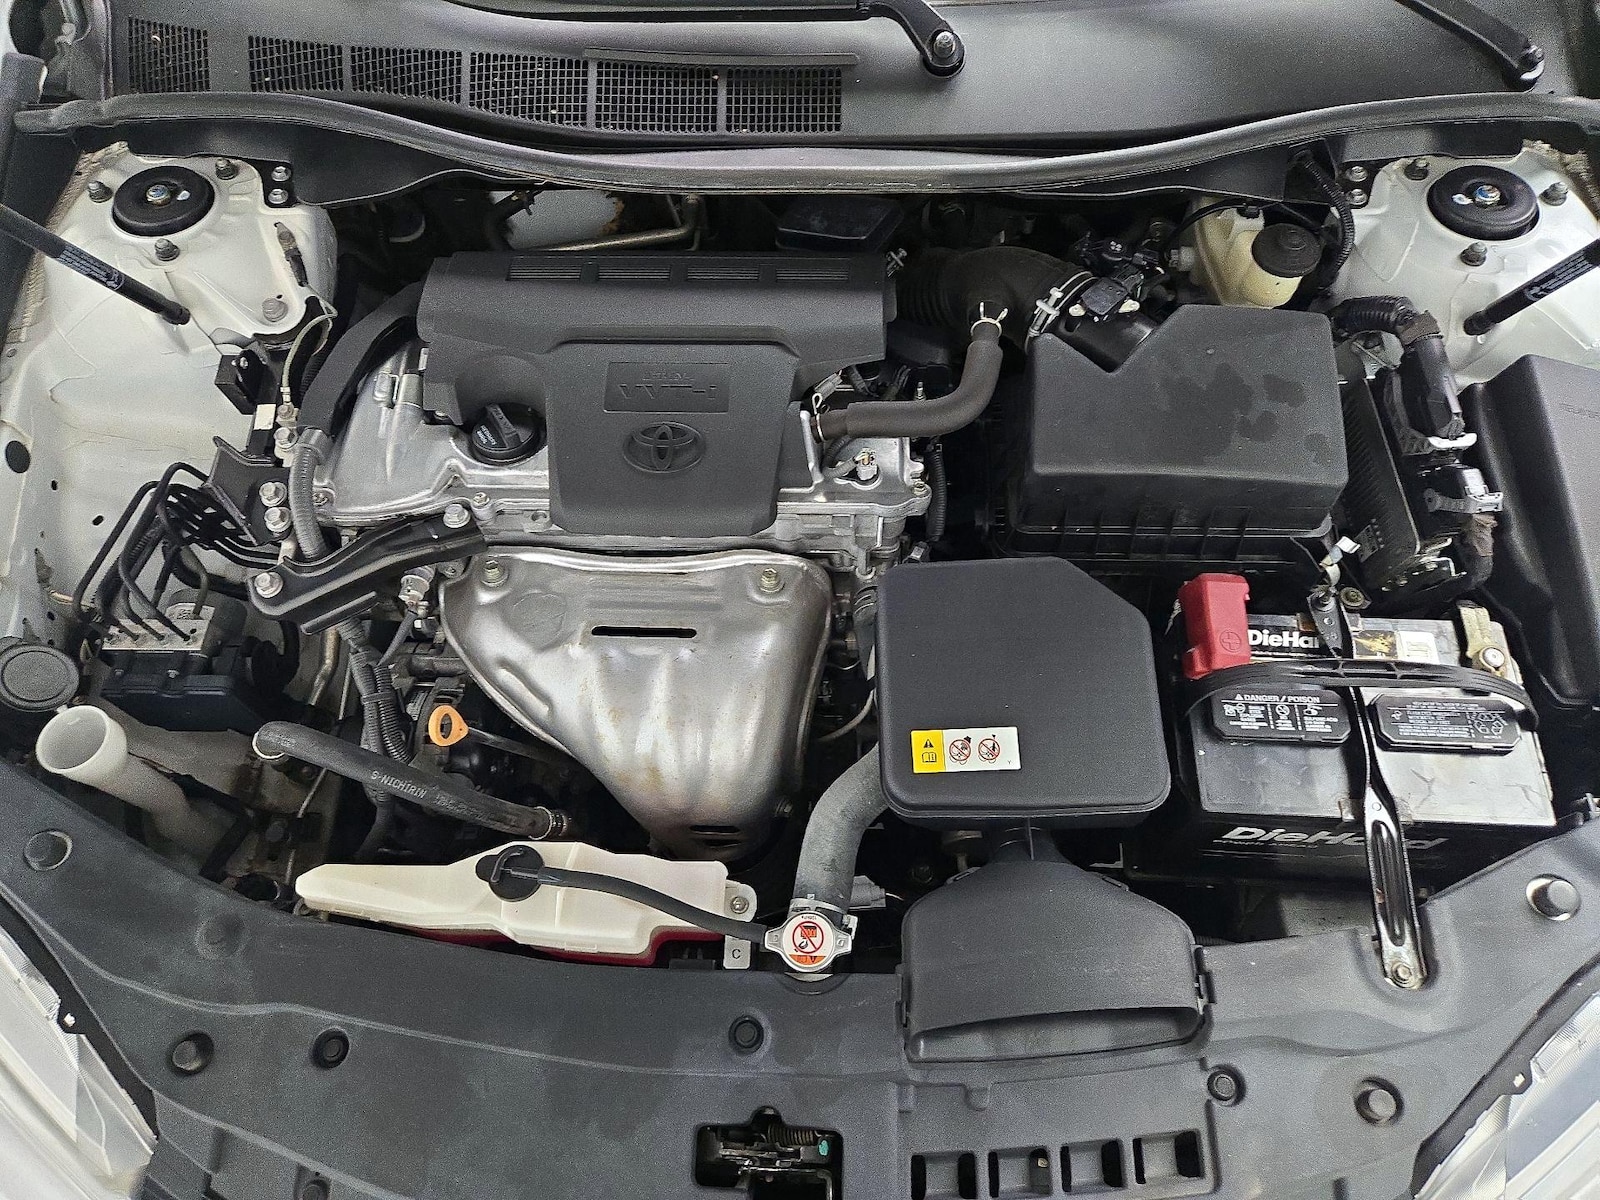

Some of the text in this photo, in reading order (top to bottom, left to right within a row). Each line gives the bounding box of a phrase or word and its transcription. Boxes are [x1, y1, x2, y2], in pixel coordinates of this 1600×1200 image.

[1244, 694, 1280, 702] DANGER
[1287, 695, 1321, 704] POISON
[731, 948, 741, 960] C
